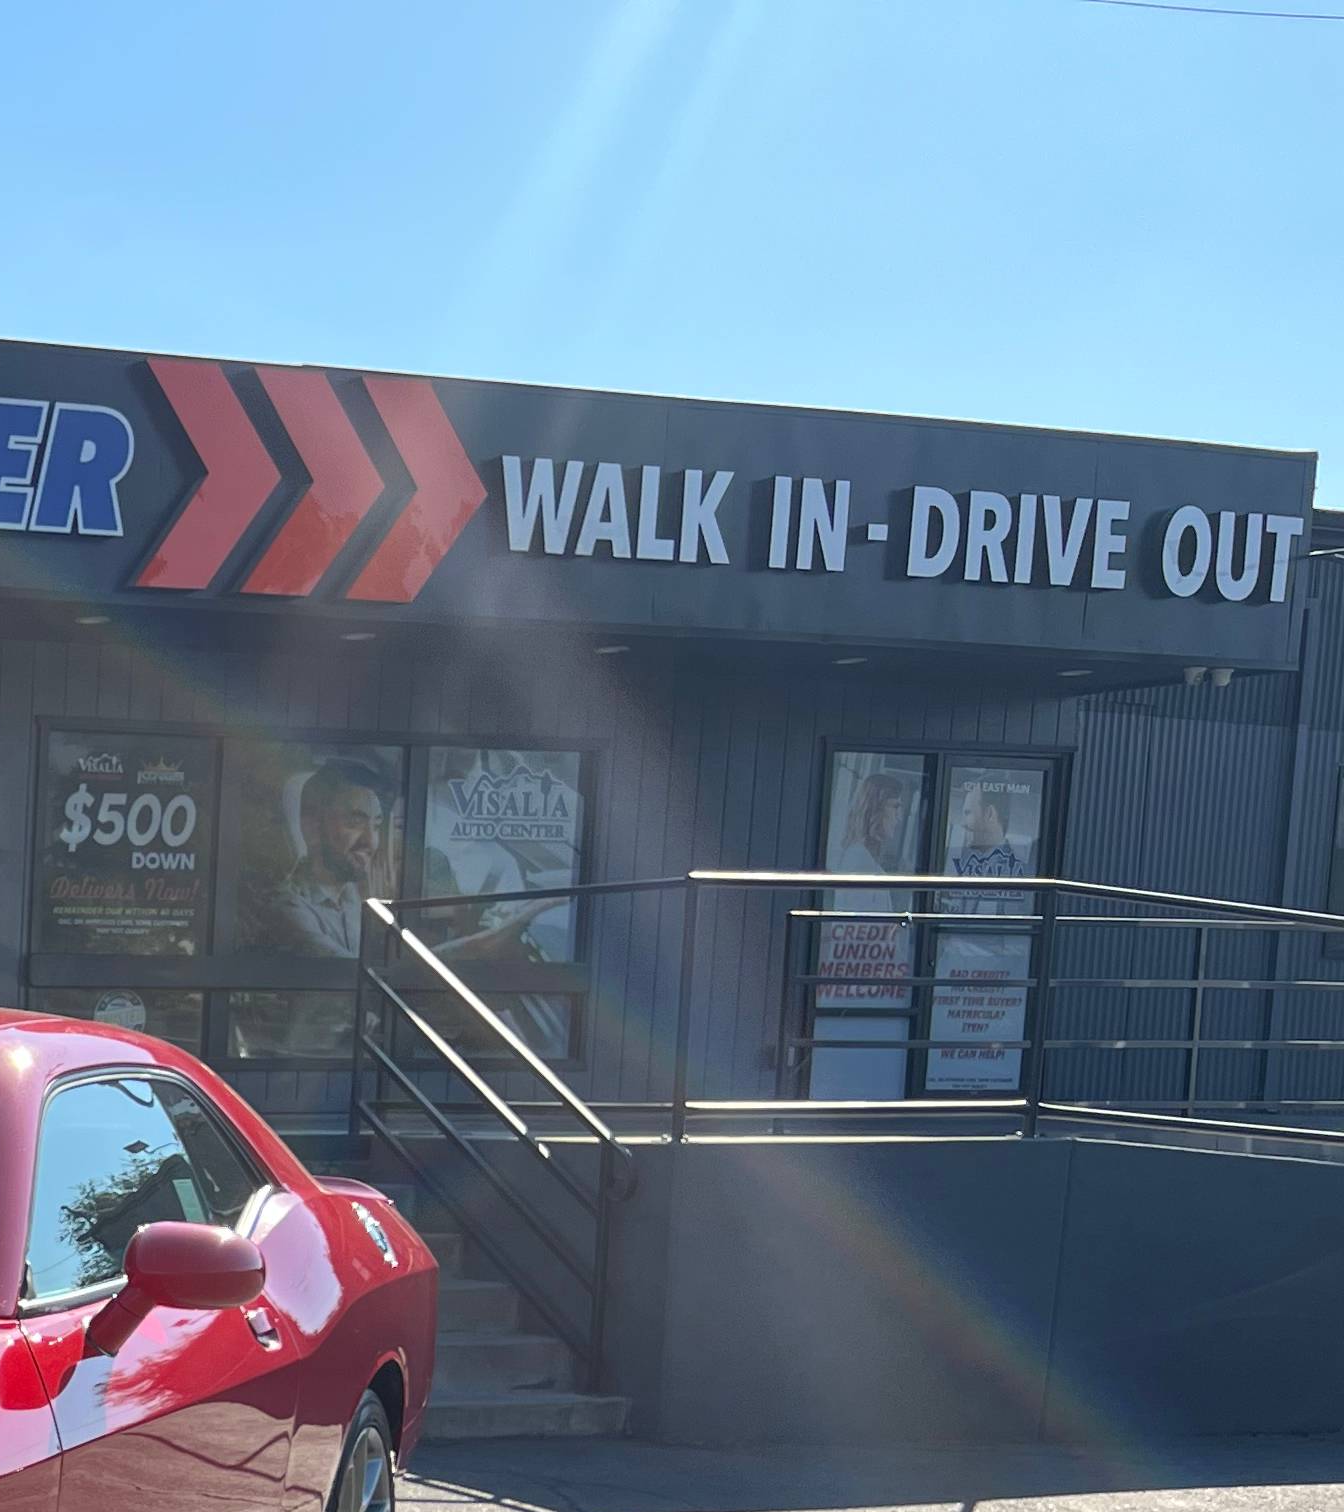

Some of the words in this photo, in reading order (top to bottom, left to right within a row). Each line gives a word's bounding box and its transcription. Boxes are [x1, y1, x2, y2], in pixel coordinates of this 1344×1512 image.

[502, 455, 734, 565] WALK
[1163, 505, 1303, 603] OUT
[78, 753, 124, 774] VISALIA
[449, 765, 569, 818] VISALIA
[983, 782, 1005, 793] EAST
[1007, 784, 1031, 794] MAIN
[60, 783, 197, 853] $500
[452, 822, 495, 837] AUTO
[498, 823, 565, 838] CENTER
[132, 852, 195, 870] DOWN
[50, 876, 135, 901] Delivers
[145, 877, 201, 901] Now!
[832, 924, 896, 941] CREDIT
[834, 943, 896, 960] UNION
[820, 962, 910, 978] MEMBERS
[949, 969, 969, 978] BAD
[817, 983, 905, 998] WELCOME
[940, 1047, 955, 1059] WE
[957, 1048, 976, 1059] CAN
[978, 1049, 1006, 1060] HELP!
